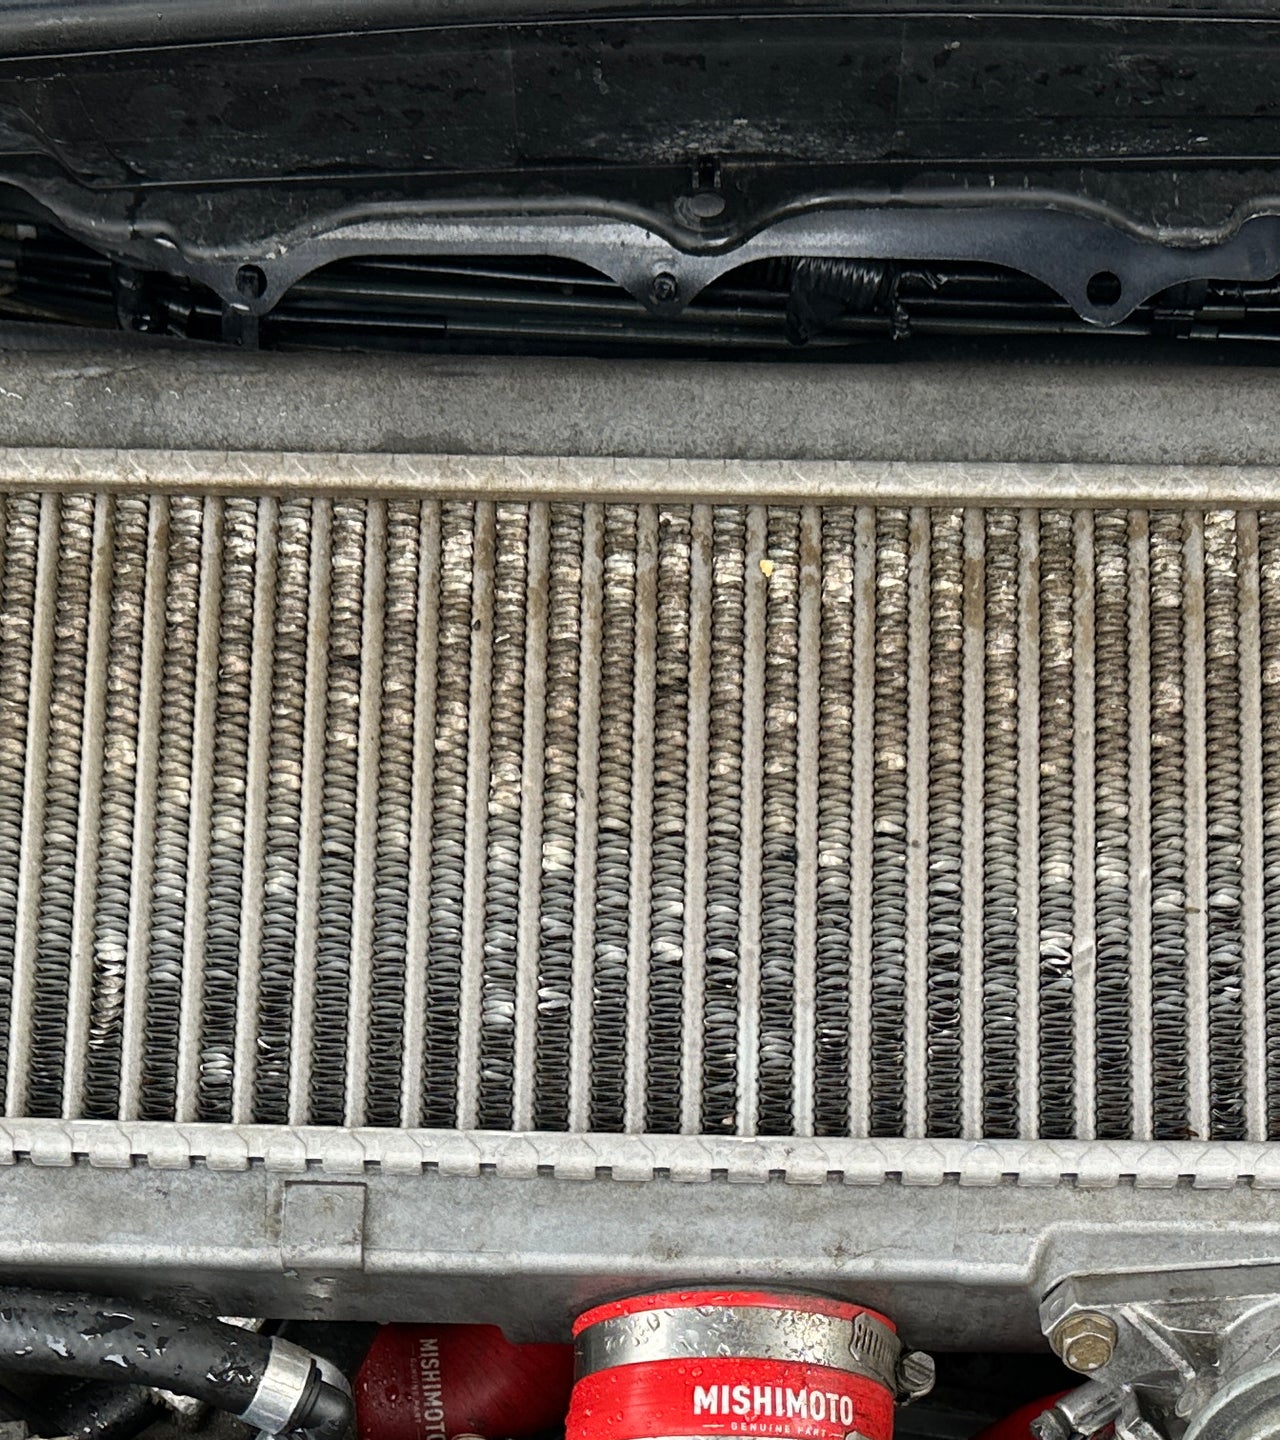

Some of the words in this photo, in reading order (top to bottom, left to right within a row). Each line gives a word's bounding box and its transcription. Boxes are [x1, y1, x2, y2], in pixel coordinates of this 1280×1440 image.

[693, 1384, 853, 1426] MISHIMOTO
[731, 1421, 791, 1434] GENUINE
[797, 1426, 827, 1438] PART
